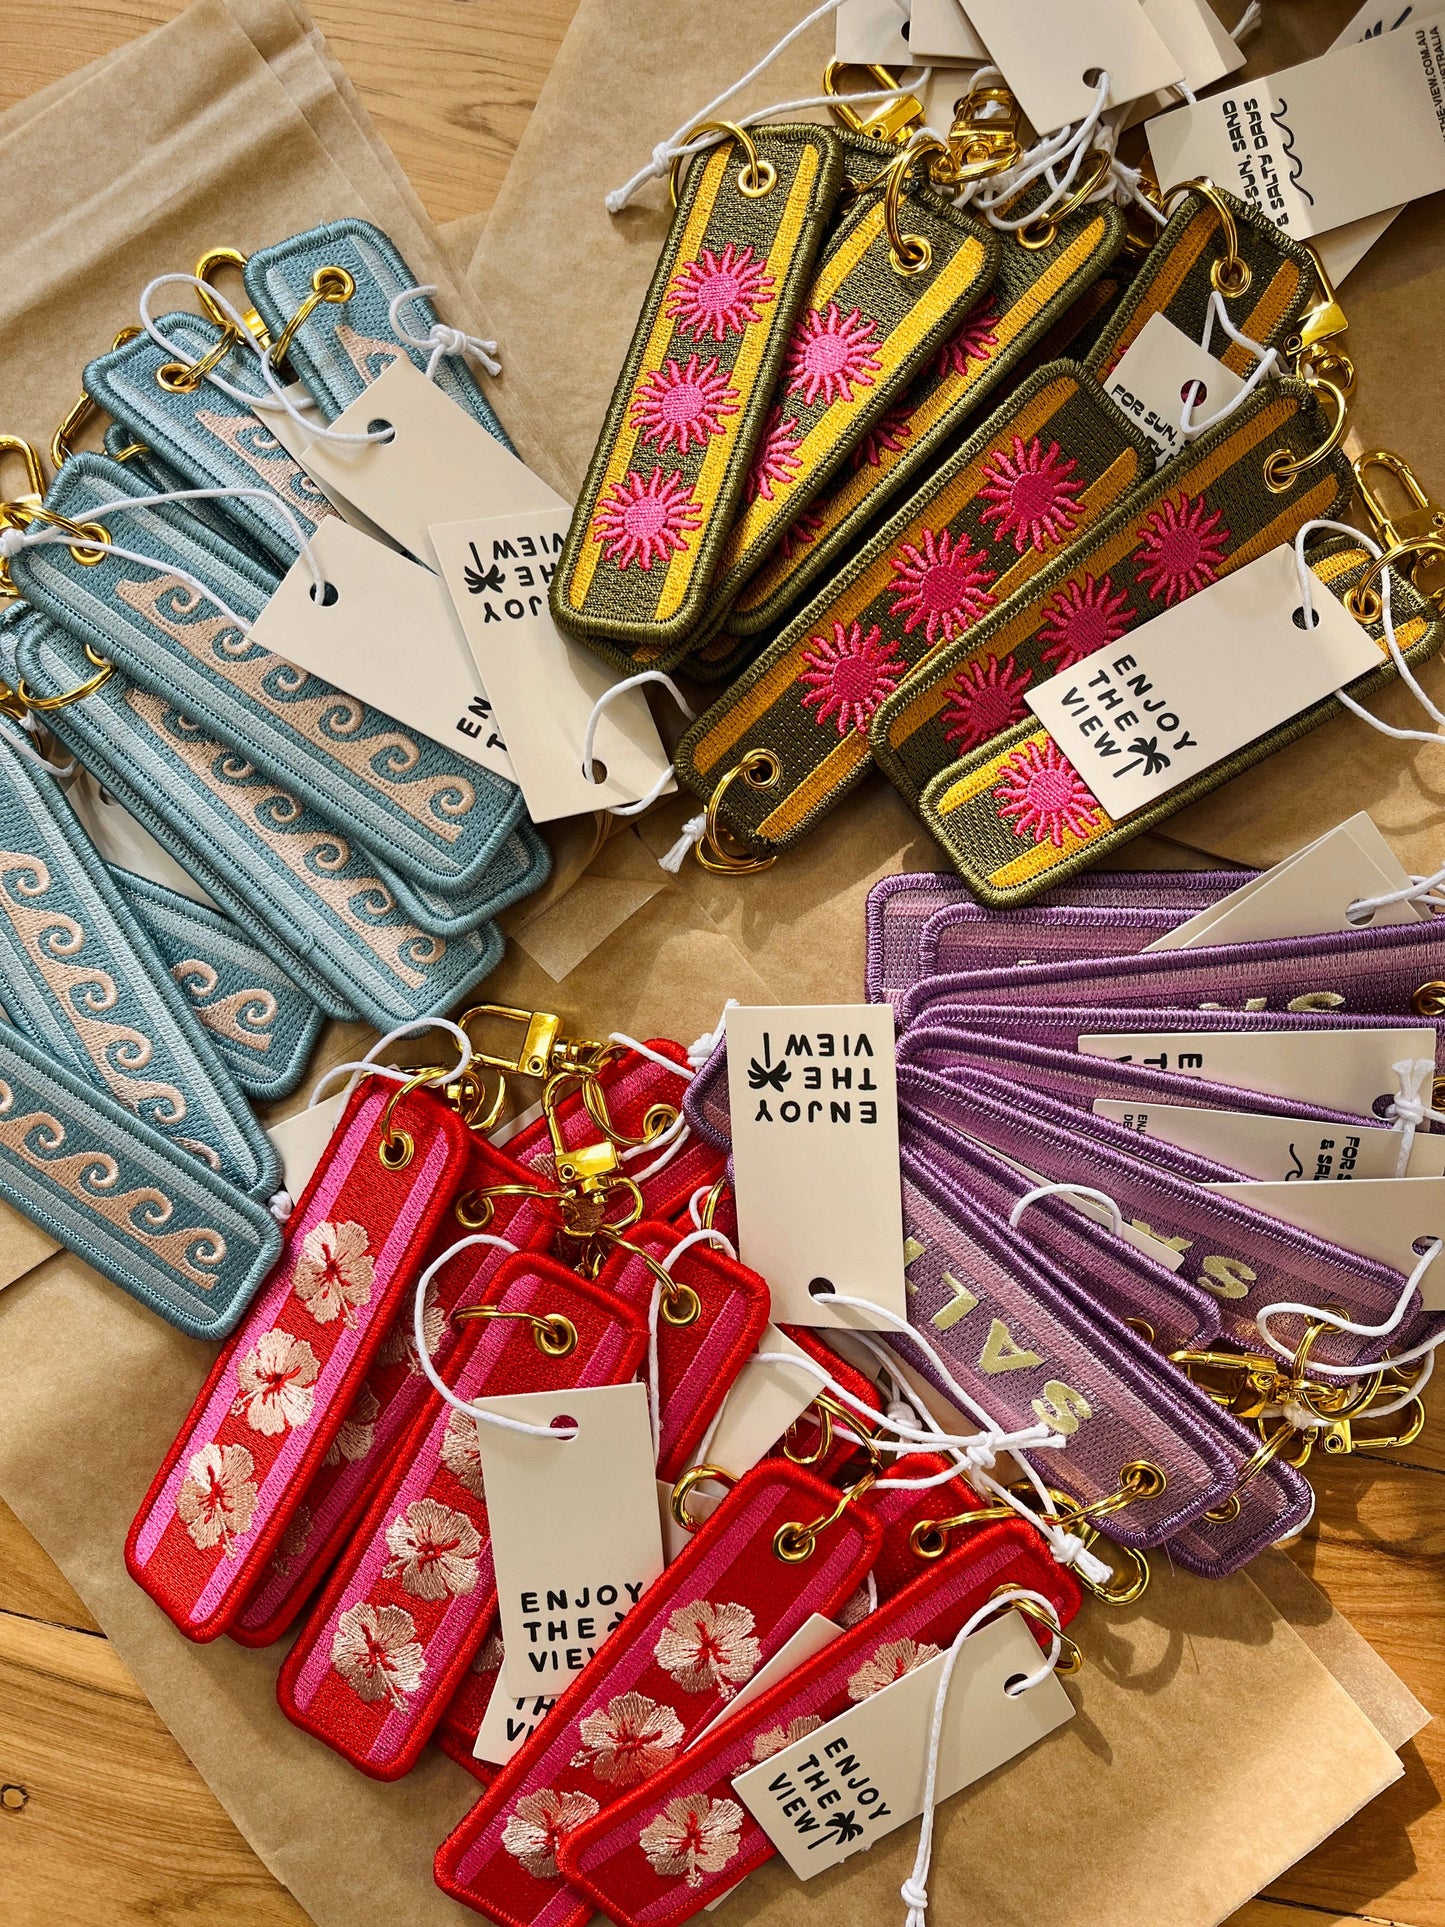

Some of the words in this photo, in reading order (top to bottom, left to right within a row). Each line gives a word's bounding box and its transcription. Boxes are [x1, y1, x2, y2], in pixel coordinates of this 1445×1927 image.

[1222, 100, 1247, 153] SAND
[1243, 98, 1268, 150] DAYS
[1238, 154, 1259, 199] SUN,
[1258, 154, 1285, 210] SALTY
[1276, 212, 1290, 227] &
[1111, 383, 1145, 417] FOR
[1143, 411, 1178, 447] SUN,
[514, 562, 557, 587] HE
[484, 594, 550, 624] JOY
[1061, 686, 1122, 757] VIEW
[1088, 669, 1140, 732] THE
[1112, 654, 1197, 750] ENJOY
[785, 1033, 874, 1057] VIEW
[803, 1066, 877, 1090] THE
[755, 1099, 877, 1124] ENJOY
[1339, 1136, 1361, 1170] FOR
[520, 1581, 643, 1613] ENJOY
[523, 1617, 597, 1643] THE
[797, 1754, 842, 1810] THE
[824, 1737, 892, 1820] ENJOY
[768, 1772, 821, 1834] VIEW
